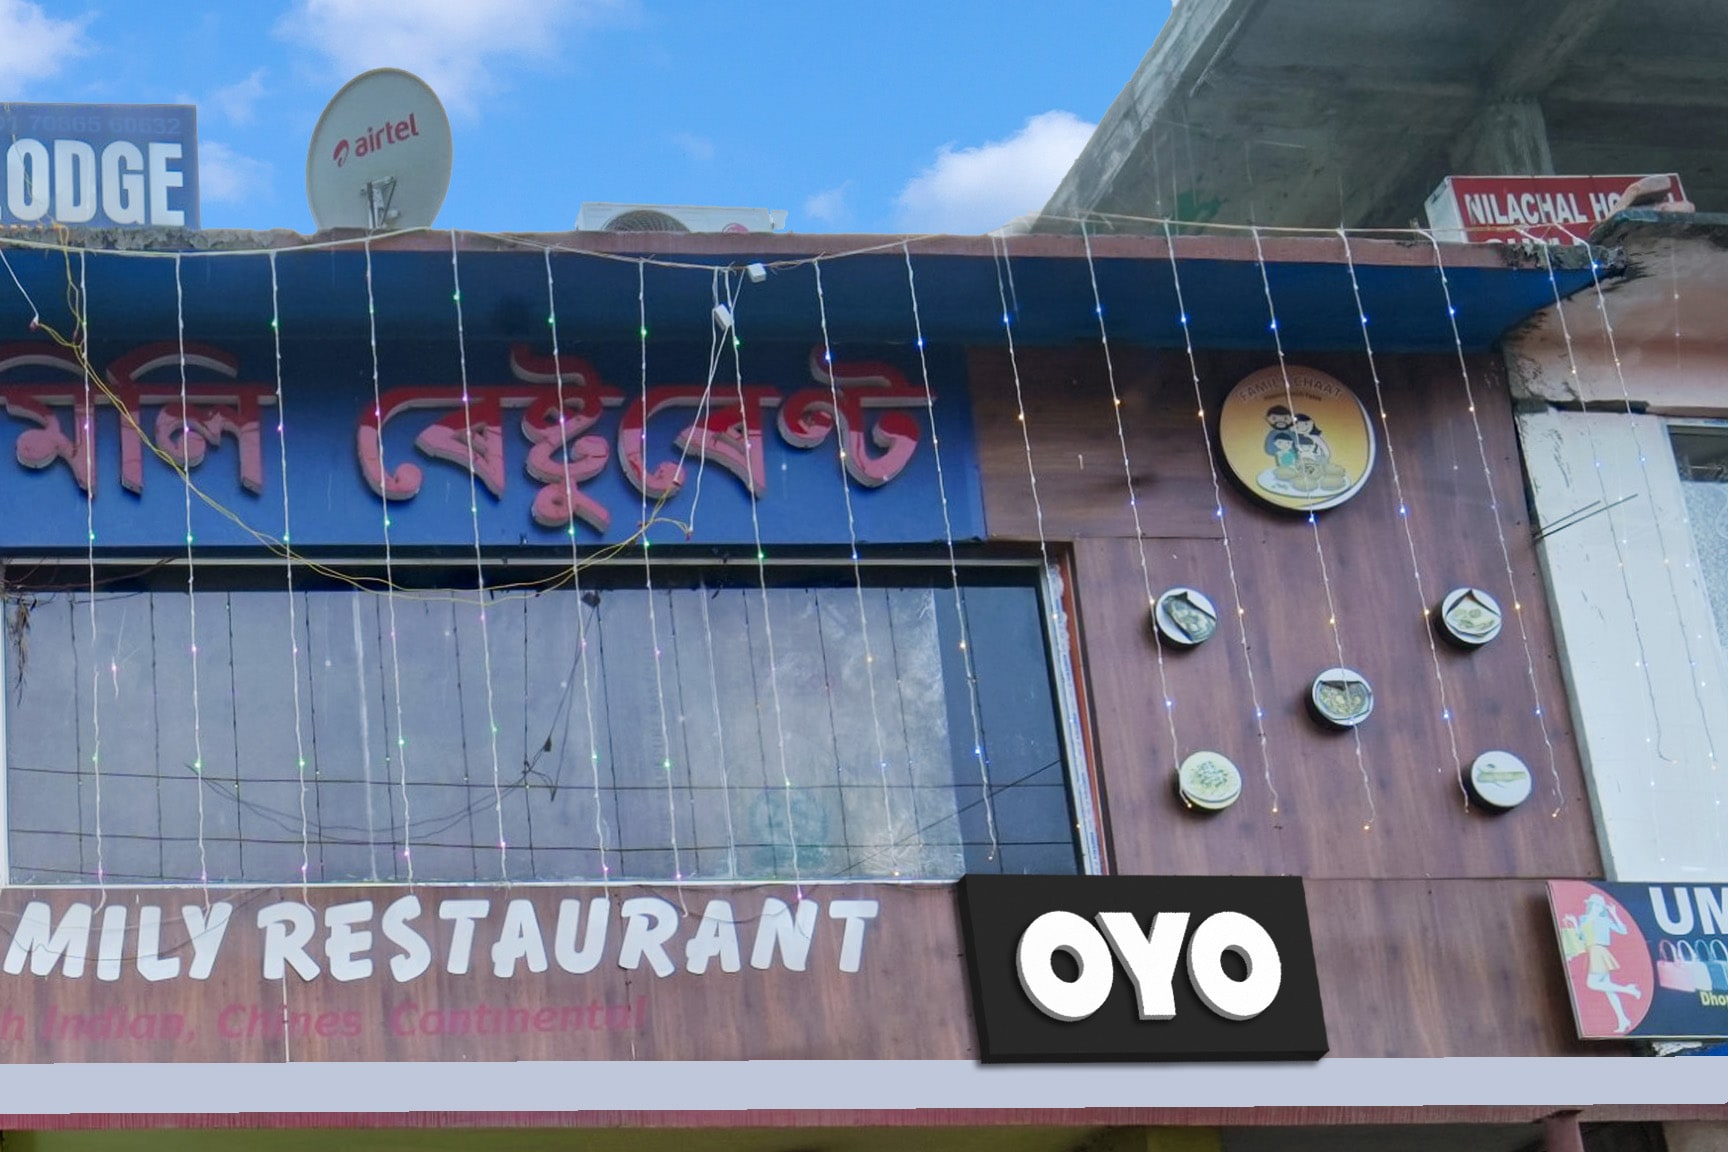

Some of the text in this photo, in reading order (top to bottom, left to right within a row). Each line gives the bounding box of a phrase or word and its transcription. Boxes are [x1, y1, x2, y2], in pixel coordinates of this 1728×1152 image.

[355, 112, 419, 157] airtel
[1464, 192, 1588, 226] NILACHAL
[257, 896, 880, 983] RESTAURANT
[1016, 910, 1282, 1022] OYO
